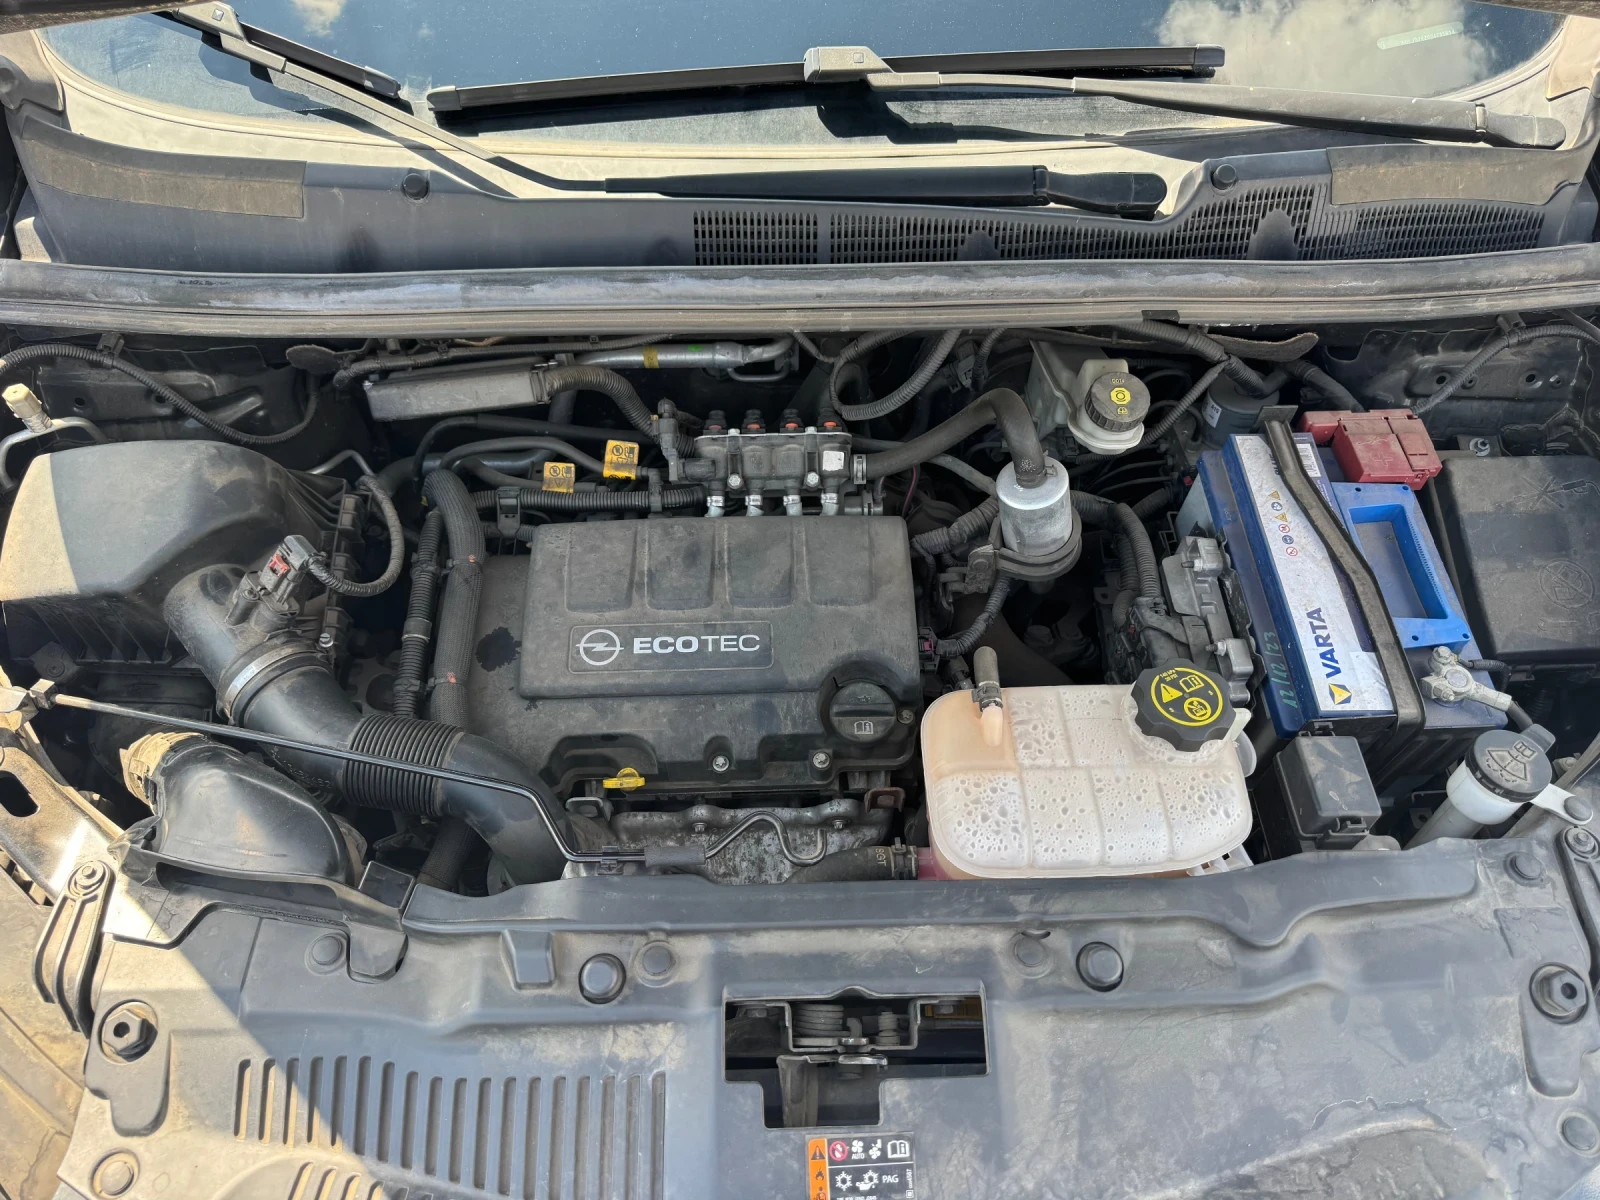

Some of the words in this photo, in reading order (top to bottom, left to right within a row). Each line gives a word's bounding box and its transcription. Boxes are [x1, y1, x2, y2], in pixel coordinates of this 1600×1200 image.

[633, 634, 761, 655] ECOTEC
[1306, 607, 1342, 679] VARTA
[882, 1174, 899, 1184] PAG
